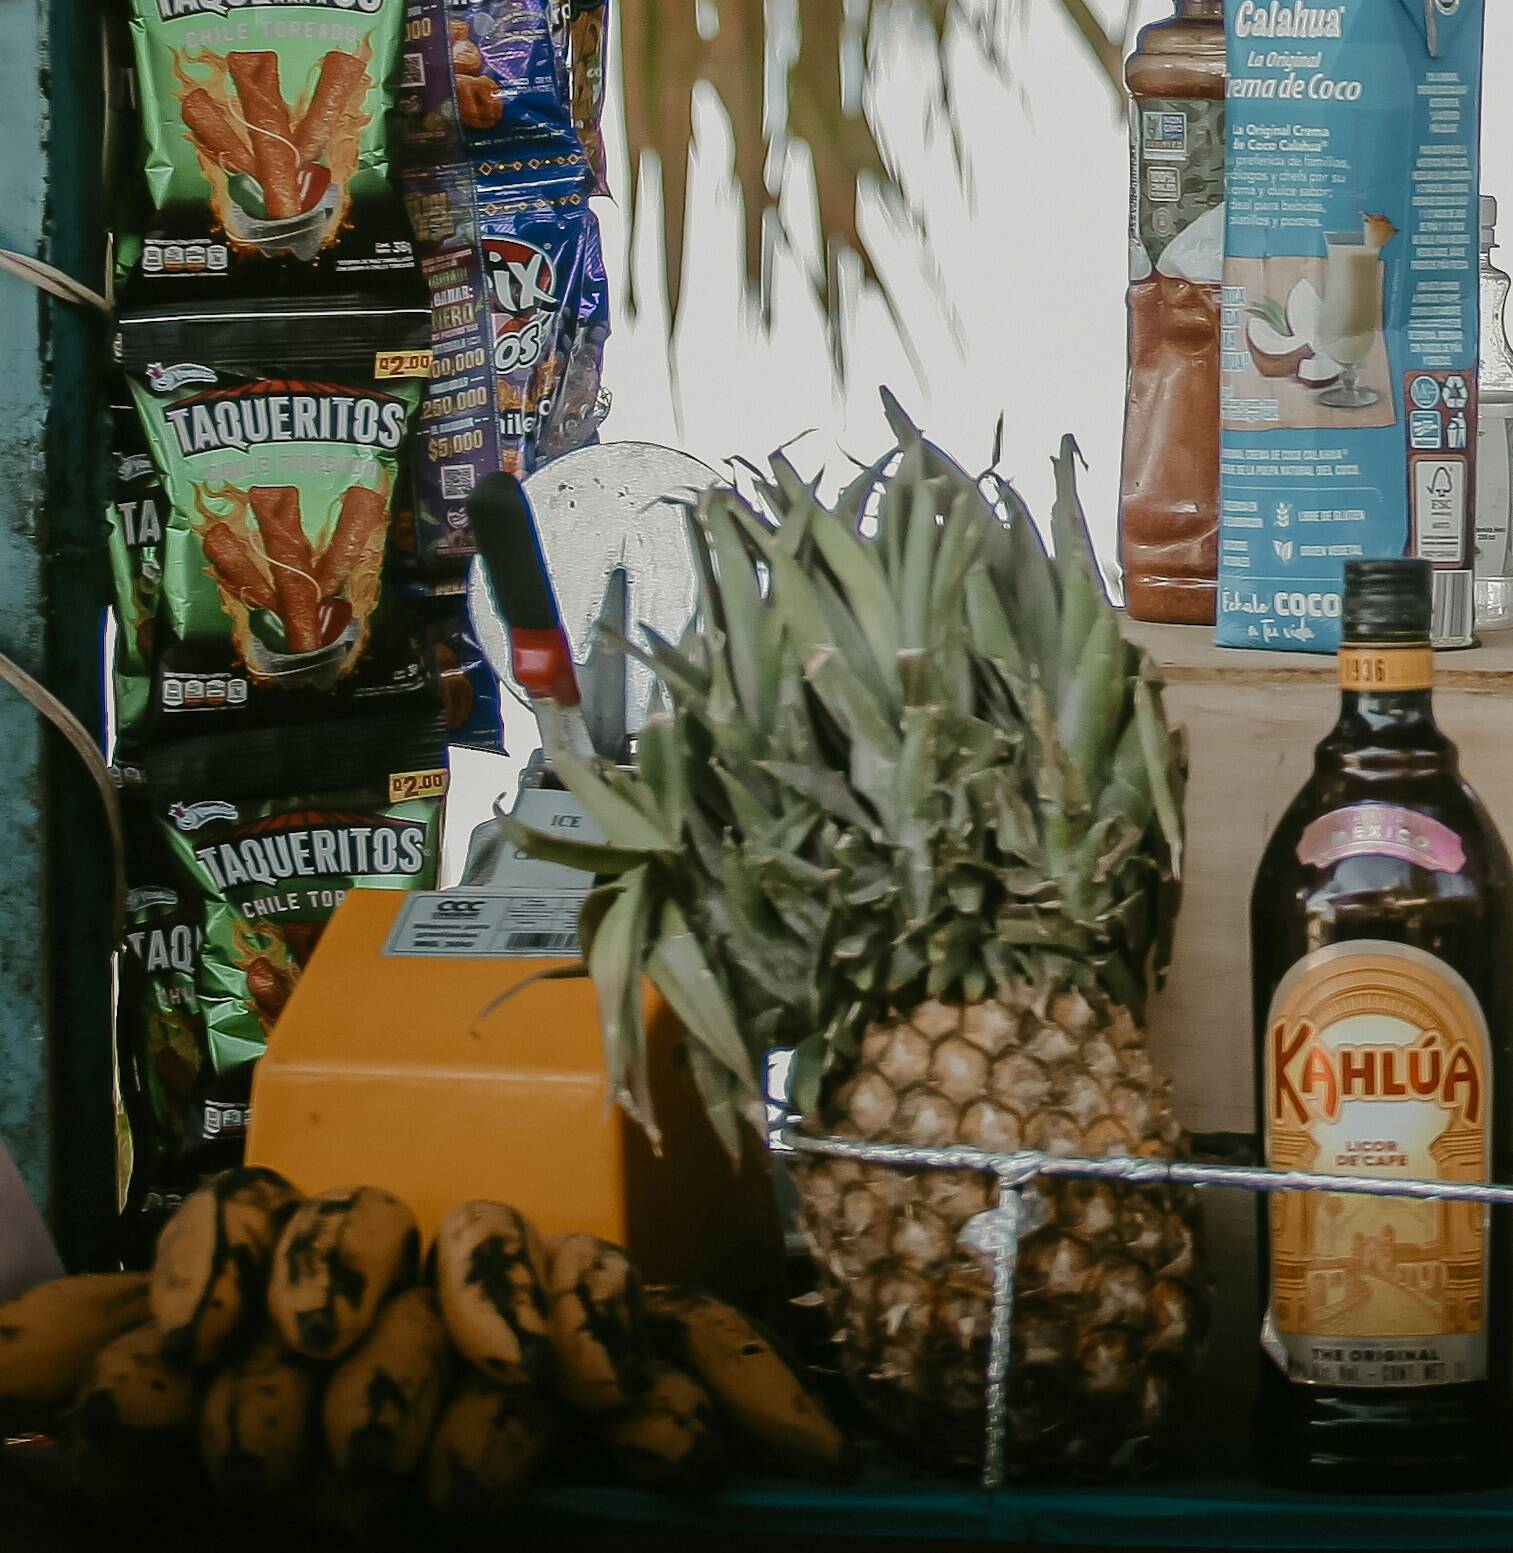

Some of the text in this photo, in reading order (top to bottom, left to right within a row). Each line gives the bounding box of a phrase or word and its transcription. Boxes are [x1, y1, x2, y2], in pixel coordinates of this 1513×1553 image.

[1235, 0, 1342, 38] Calahua
[1248, 51, 1322, 71] La Original
[1225, 72, 1362, 100] rema de Coco
[1246, 125, 1291, 138] Original
[379, 355, 431, 376] Q2.00
[166, 397, 404, 452] TAQUERITOS
[1273, 590, 1343, 617] COCO
[393, 773, 444, 798] Q2.00
[551, 814, 583, 829] ICE
[197, 826, 425, 890] TAQUERITOS
[242, 892, 300, 919] CHILE
[1273, 1023, 1479, 1124] KAHLÚA
[1345, 1140, 1398, 1152] LICOR
[1336, 1155, 1358, 1167] DE
